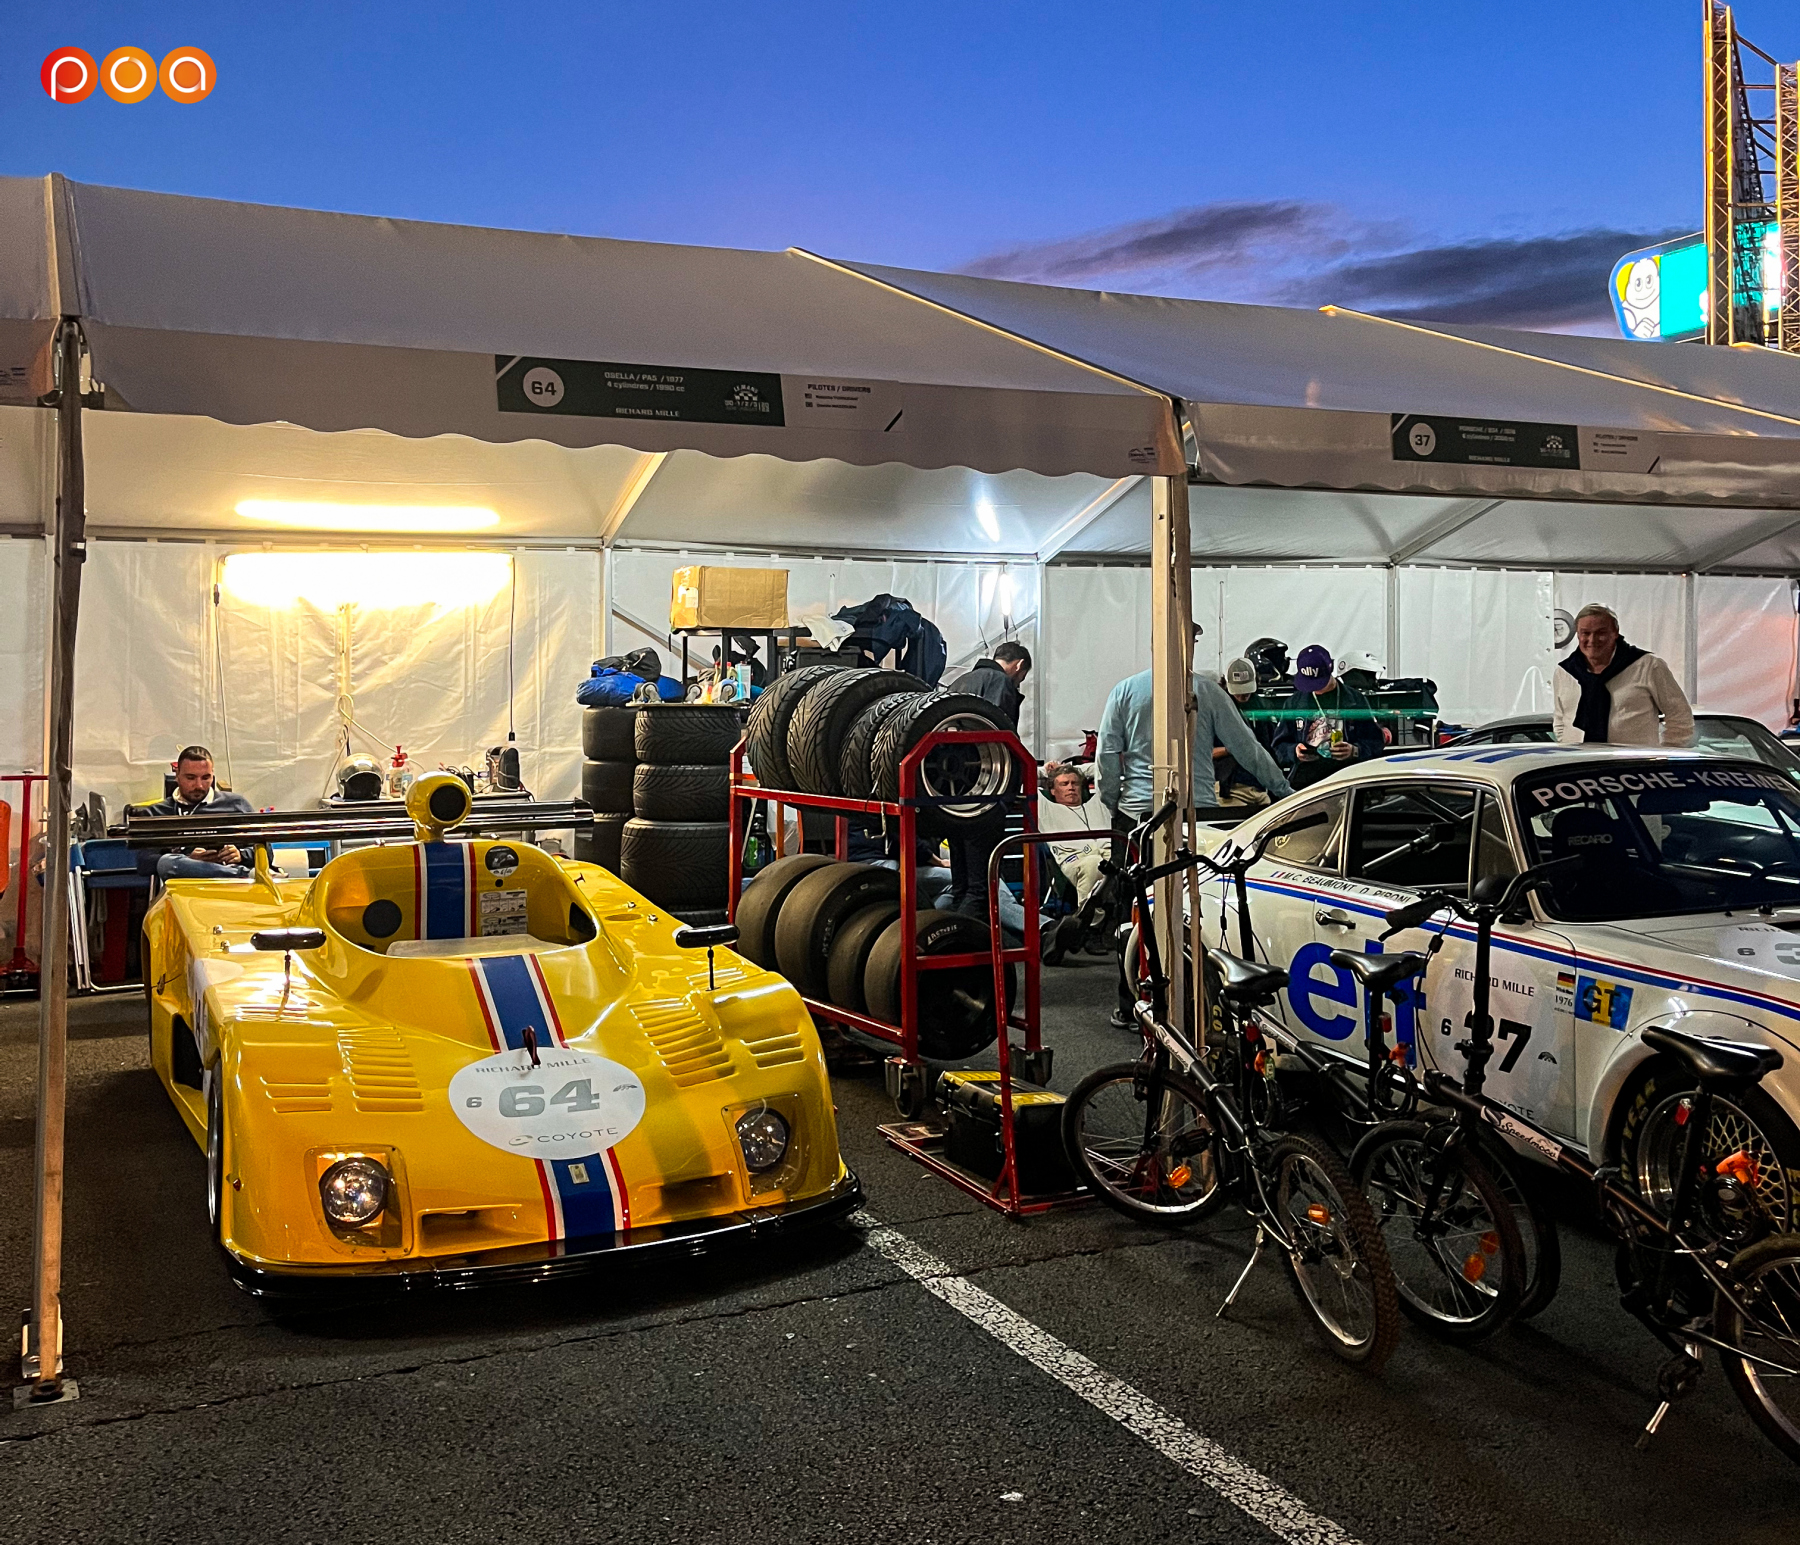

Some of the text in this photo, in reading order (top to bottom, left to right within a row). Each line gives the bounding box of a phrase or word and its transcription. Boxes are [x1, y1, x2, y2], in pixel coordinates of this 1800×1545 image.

[531, 381, 557, 396] 64
[615, 407, 681, 417] RICHARD MILLE
[1415, 434, 1431, 447] 37
[1300, 666, 1319, 678] ally
[1567, 832, 1613, 846] RECARO
[1302, 875, 1358, 894] BEAUMONT
[1454, 967, 1499, 988] RICHD
[1502, 979, 1535, 998] MILLE
[1555, 994, 1574, 1008] 1976
[1583, 984, 1622, 1018] GT
[1440, 1017, 1452, 1036] 6
[475, 1057, 592, 1075] RICHARD MILLE
[465, 1078, 601, 1118] 6 64
[537, 1126, 618, 1144] COYOTE
